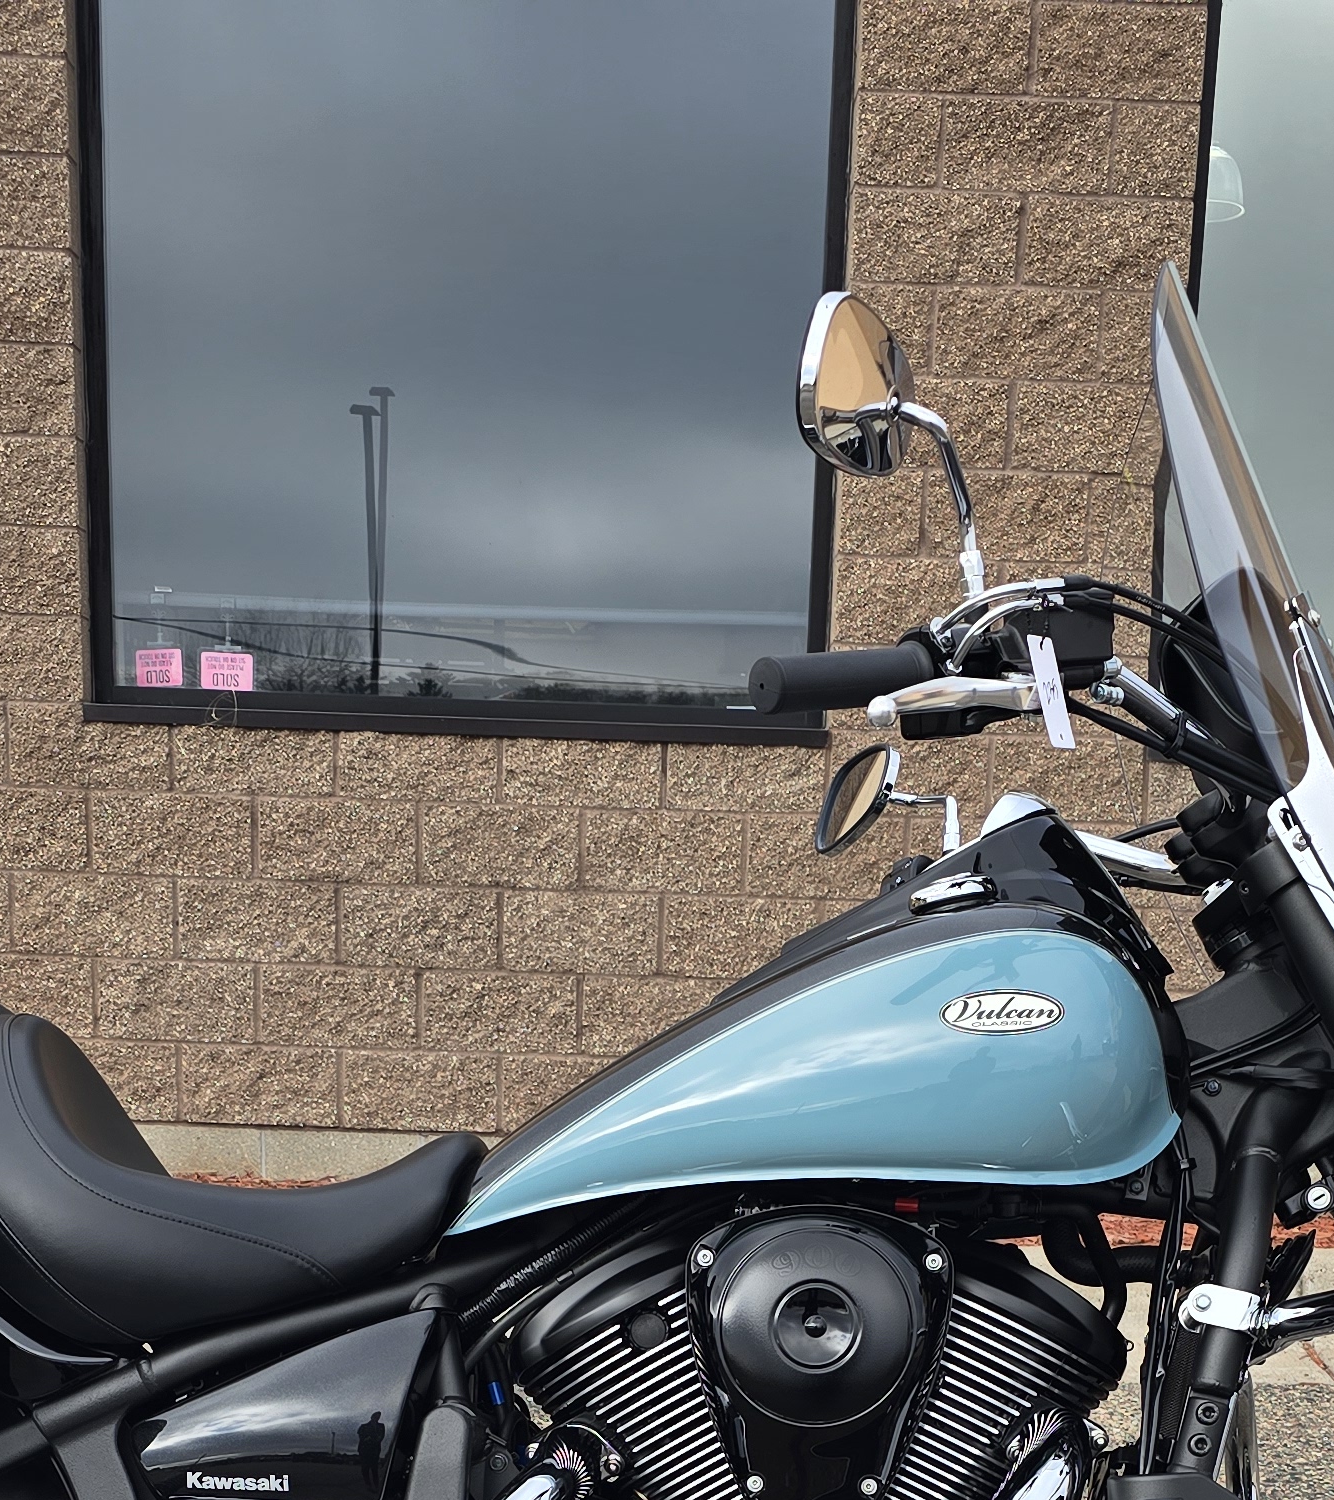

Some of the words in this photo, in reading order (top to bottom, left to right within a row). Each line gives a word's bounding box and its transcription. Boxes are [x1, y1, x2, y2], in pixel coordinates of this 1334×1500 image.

[146, 669, 171, 684] SOLD
[212, 672, 239, 687] SOLD
[951, 995, 1058, 1023] Vulcan
[971, 1020, 1033, 1028] CLASSIC
[770, 1243, 863, 1278] 900
[186, 1471, 290, 1492] Kawasaki
